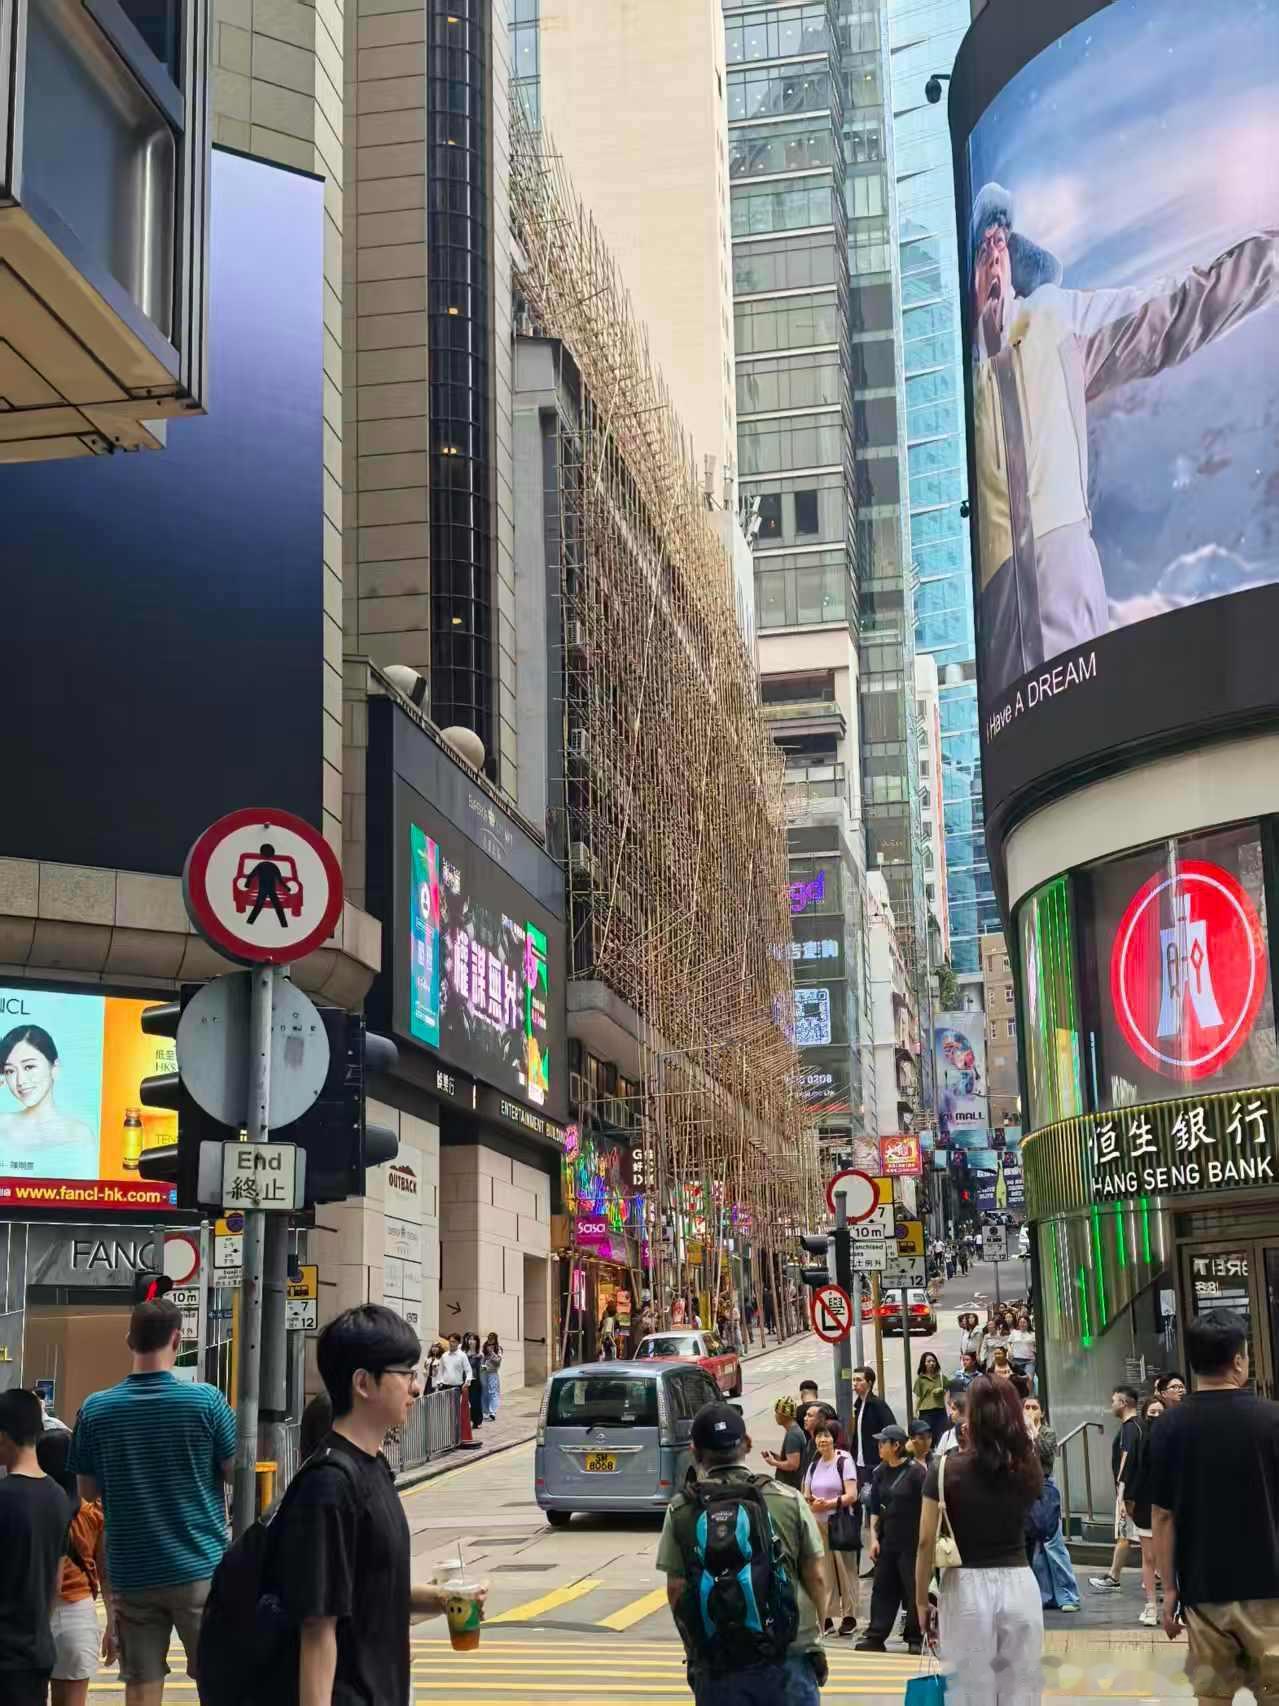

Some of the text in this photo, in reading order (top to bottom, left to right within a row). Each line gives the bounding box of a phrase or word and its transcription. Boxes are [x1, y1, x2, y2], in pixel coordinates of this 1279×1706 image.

[989, 703, 1013, 740] Have
[1015, 690, 1025, 717] A
[1027, 651, 1097, 708] DREAM
[500, 1099, 545, 1135] ENTERTAINMENT
[237, 1151, 282, 1171] End
[388, 1172, 417, 1195] OUTBACK
[1092, 1155, 1274, 1196] HANG SENG BANK
[15, 1185, 161, 1204] www.fancl-hk.com
[230, 1176, 287, 1201] 終止
[908, 1258, 916, 1269] 7
[910, 1275, 924, 1287] 12
[301, 1301, 309, 1312] 7
[301, 1317, 314, 1329] 12
